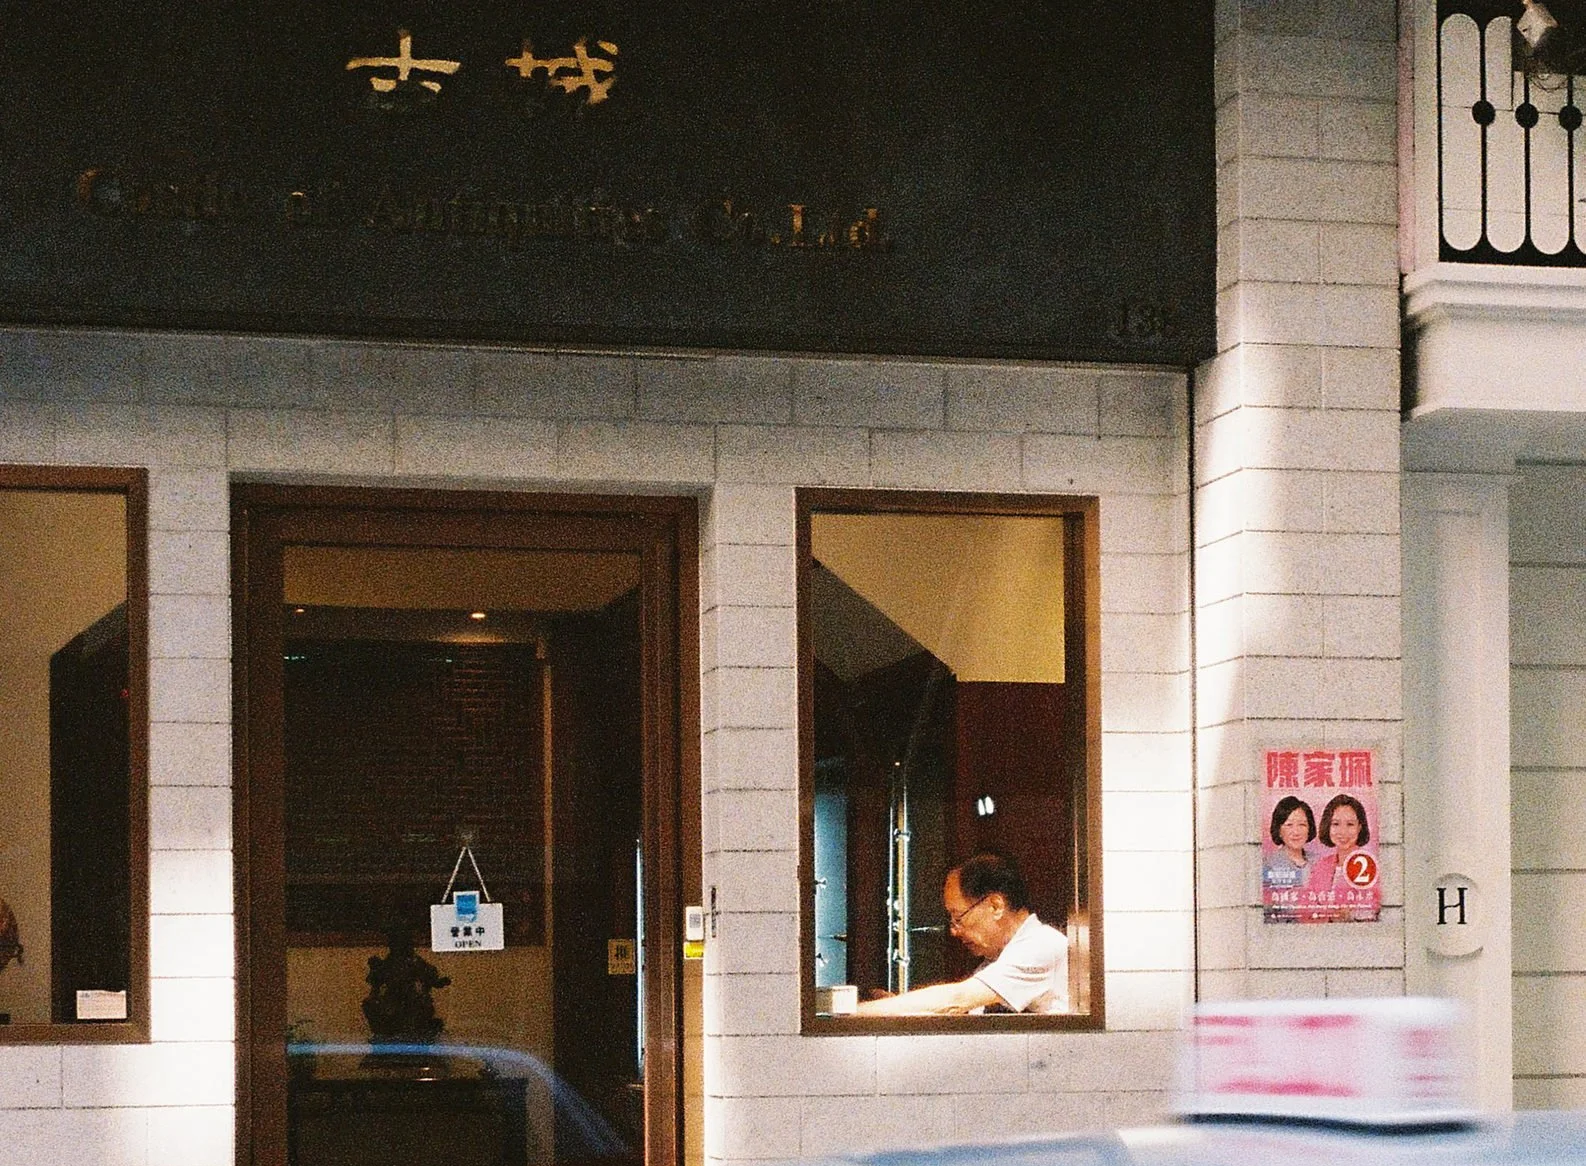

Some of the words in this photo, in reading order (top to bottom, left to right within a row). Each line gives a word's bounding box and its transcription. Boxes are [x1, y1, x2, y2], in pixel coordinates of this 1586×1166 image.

[1266, 752, 1372, 788] 陳家珮
[1353, 856, 1370, 883] 2
[1437, 888, 1467, 925] H
[454, 940, 482, 949] OPEN
